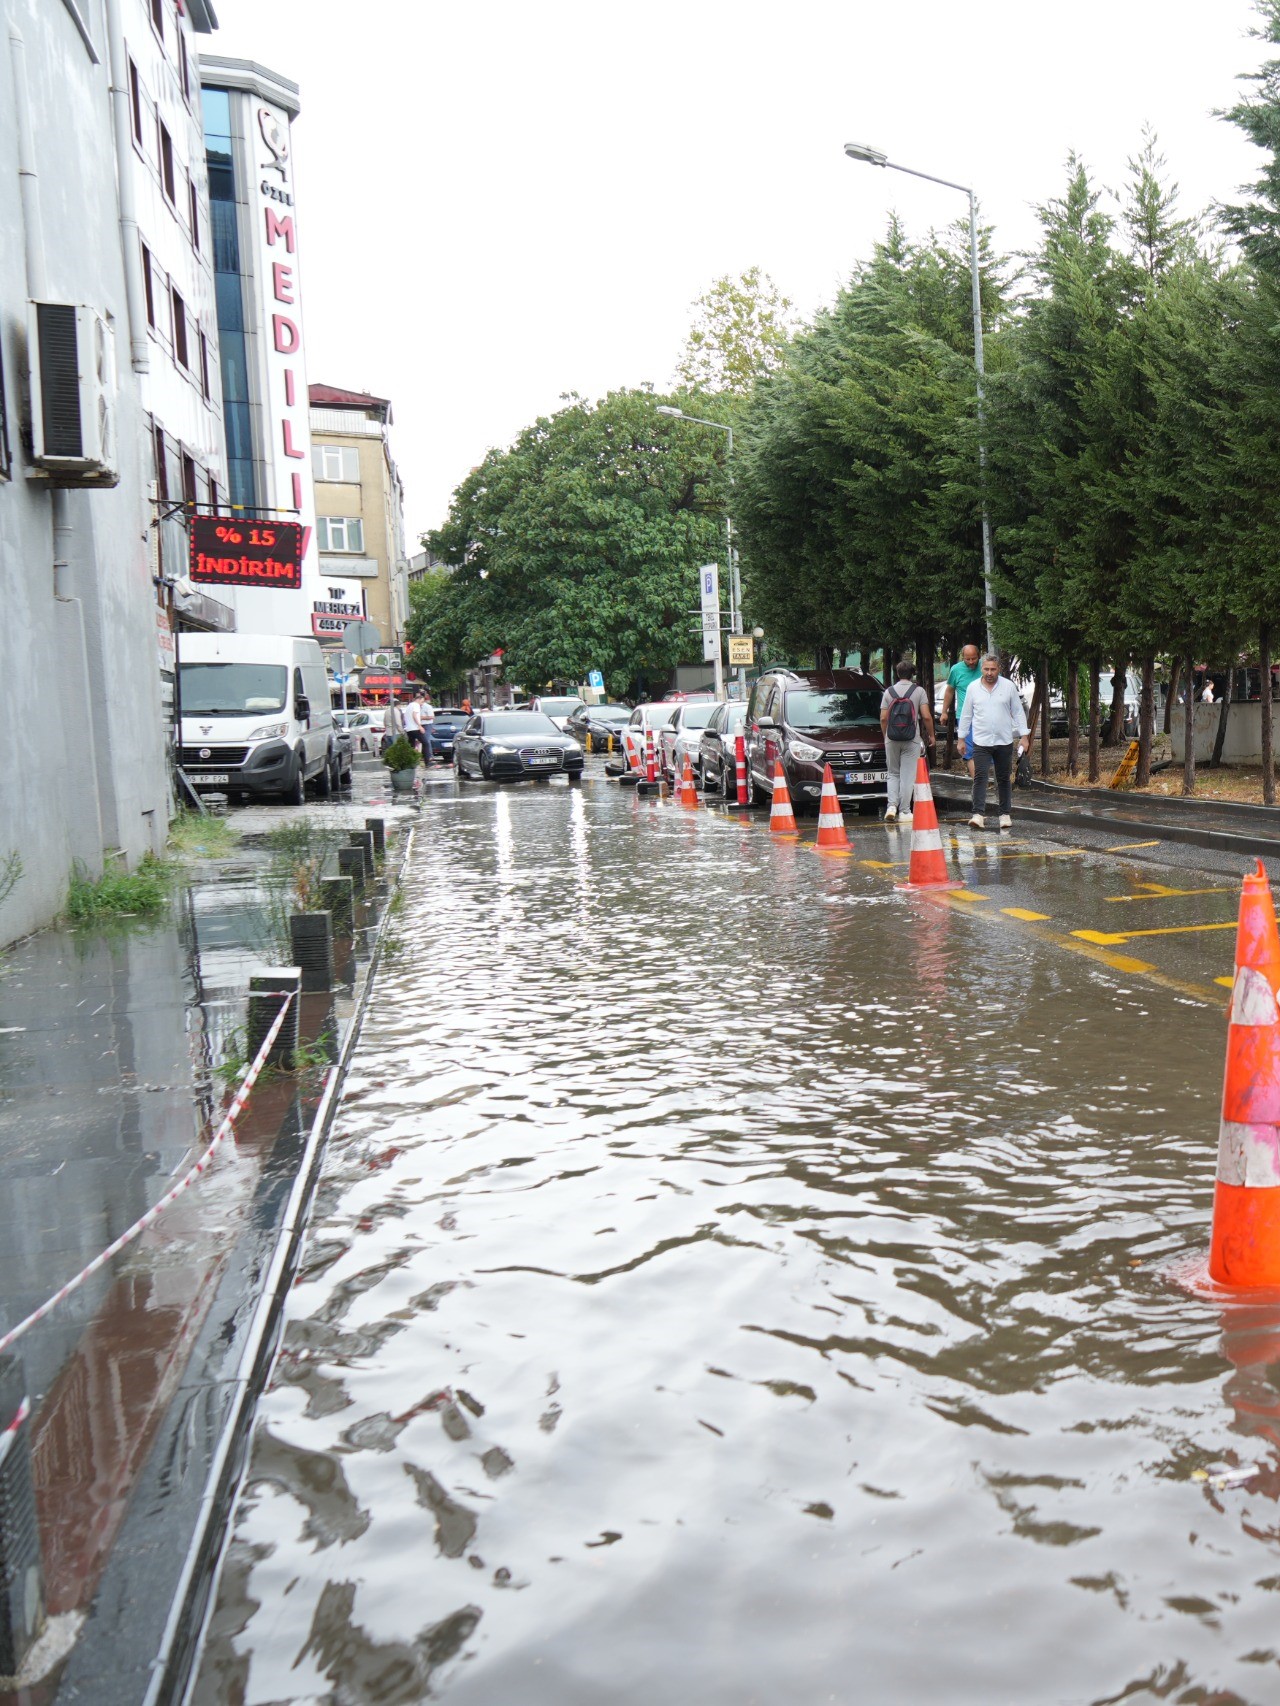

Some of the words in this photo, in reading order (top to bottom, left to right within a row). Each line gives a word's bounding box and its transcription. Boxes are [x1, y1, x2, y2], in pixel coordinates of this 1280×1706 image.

[261, 180, 294, 206] ÖZEL
[215, 526, 242, 544] %
[249, 529, 275, 546] 15
[196, 553, 294, 579] İNDİRİM
